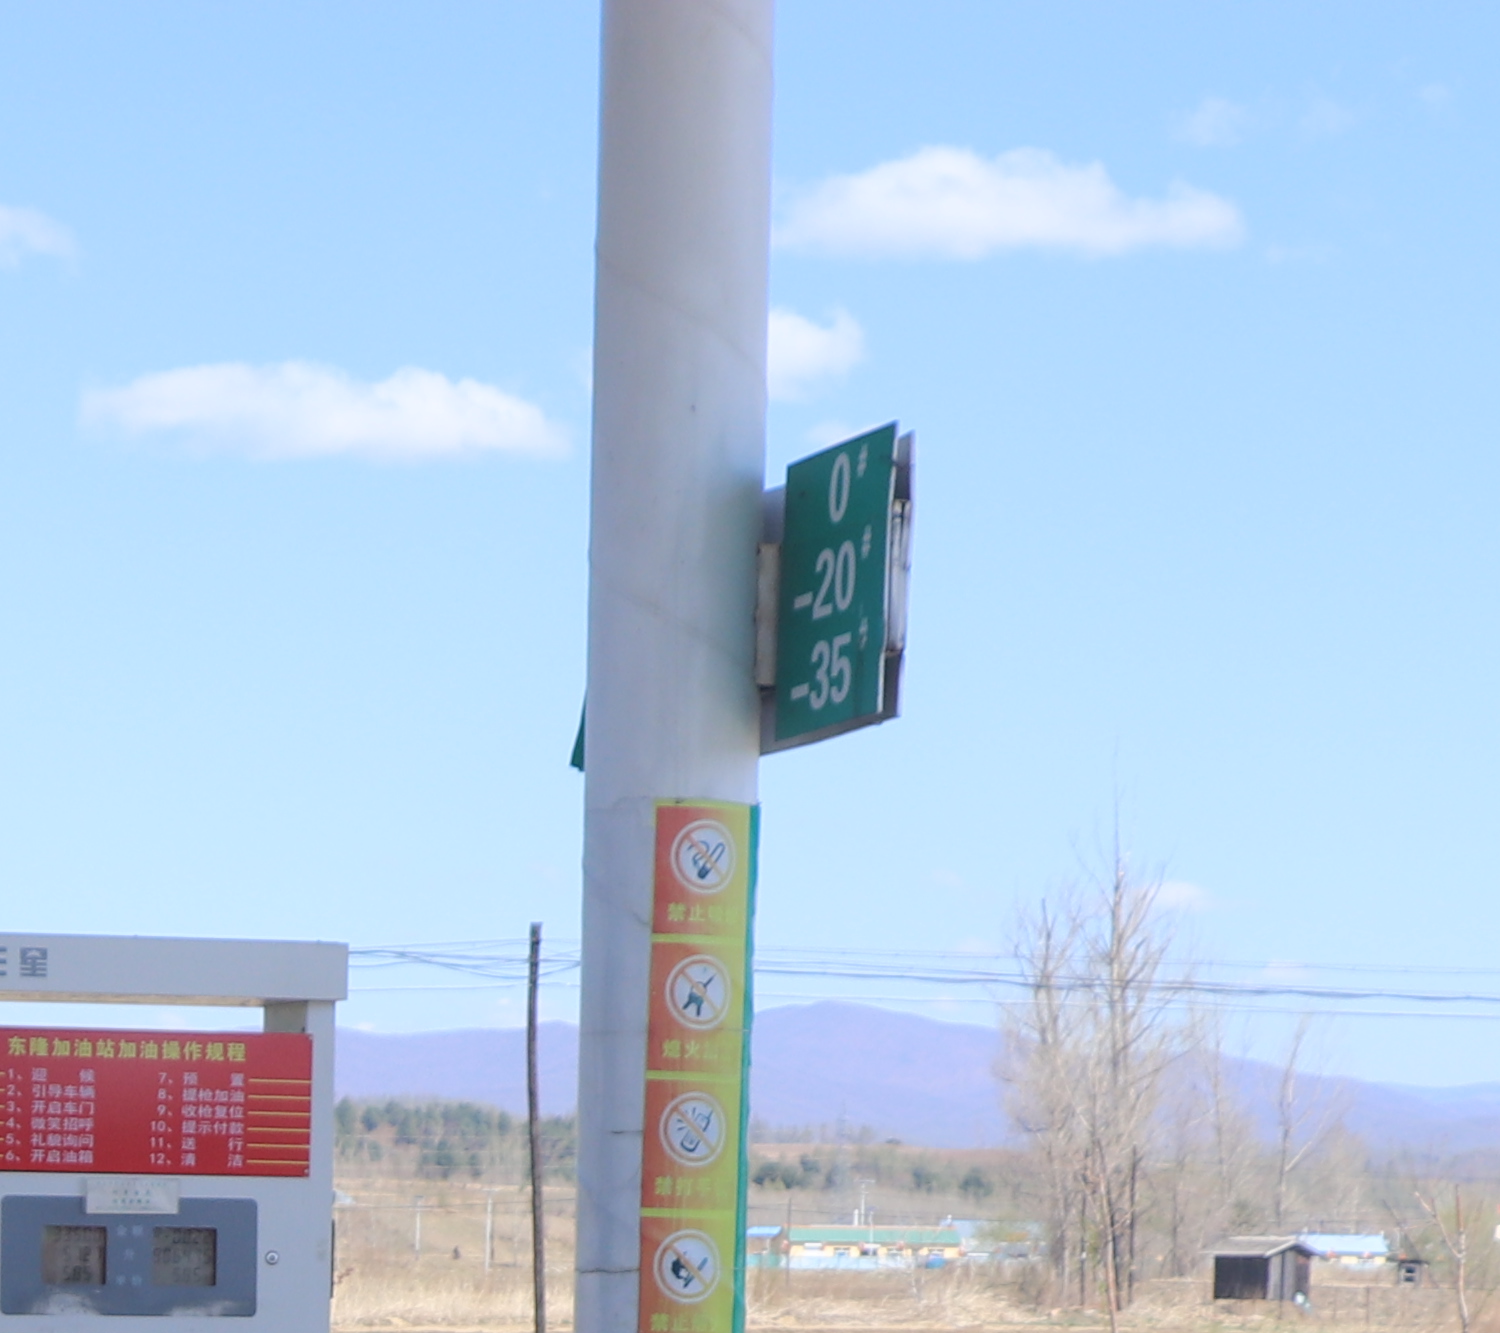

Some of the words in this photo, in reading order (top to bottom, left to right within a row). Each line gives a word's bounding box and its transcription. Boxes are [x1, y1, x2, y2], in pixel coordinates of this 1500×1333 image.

[8, 1036, 246, 1062] 东隆加油站加油操作规程
